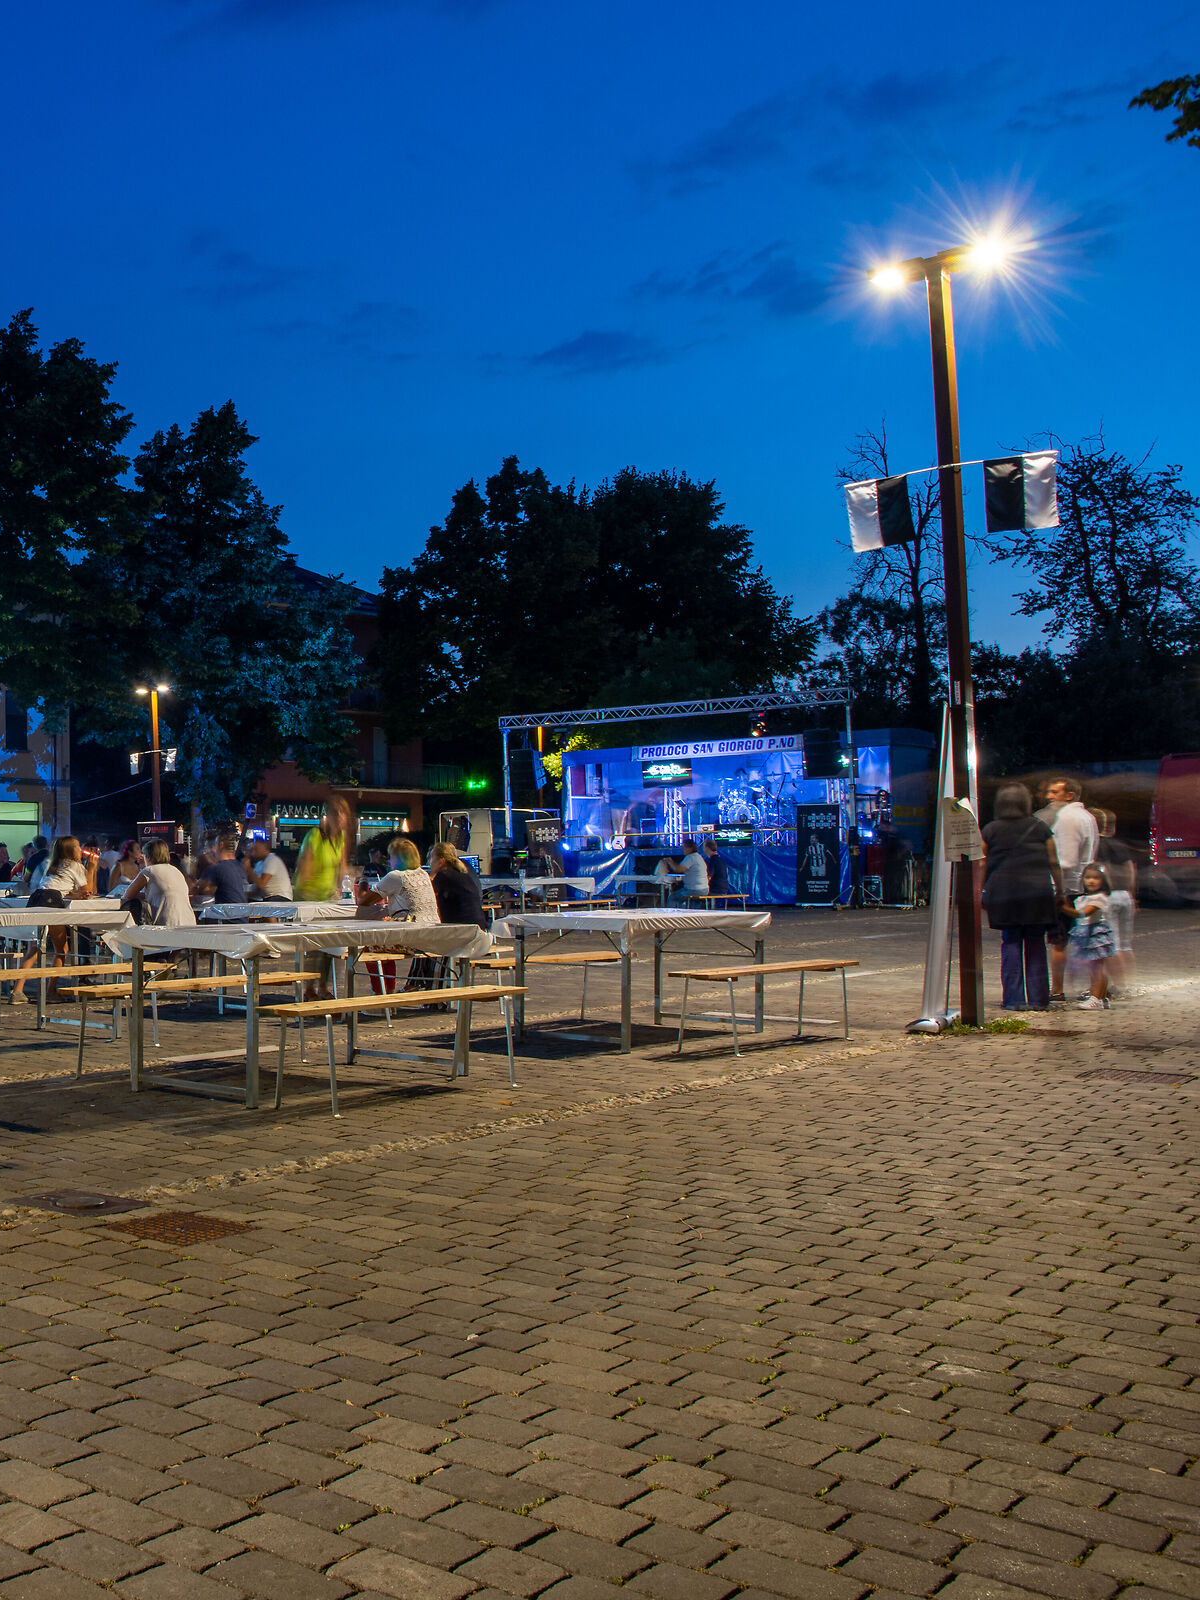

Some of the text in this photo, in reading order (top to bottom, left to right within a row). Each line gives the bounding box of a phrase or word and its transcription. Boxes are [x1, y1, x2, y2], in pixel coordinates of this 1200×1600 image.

[641, 736, 795, 758] PROLOCO SAN GIORGIO P.NO
[276, 804, 328, 816] FARMACIA
